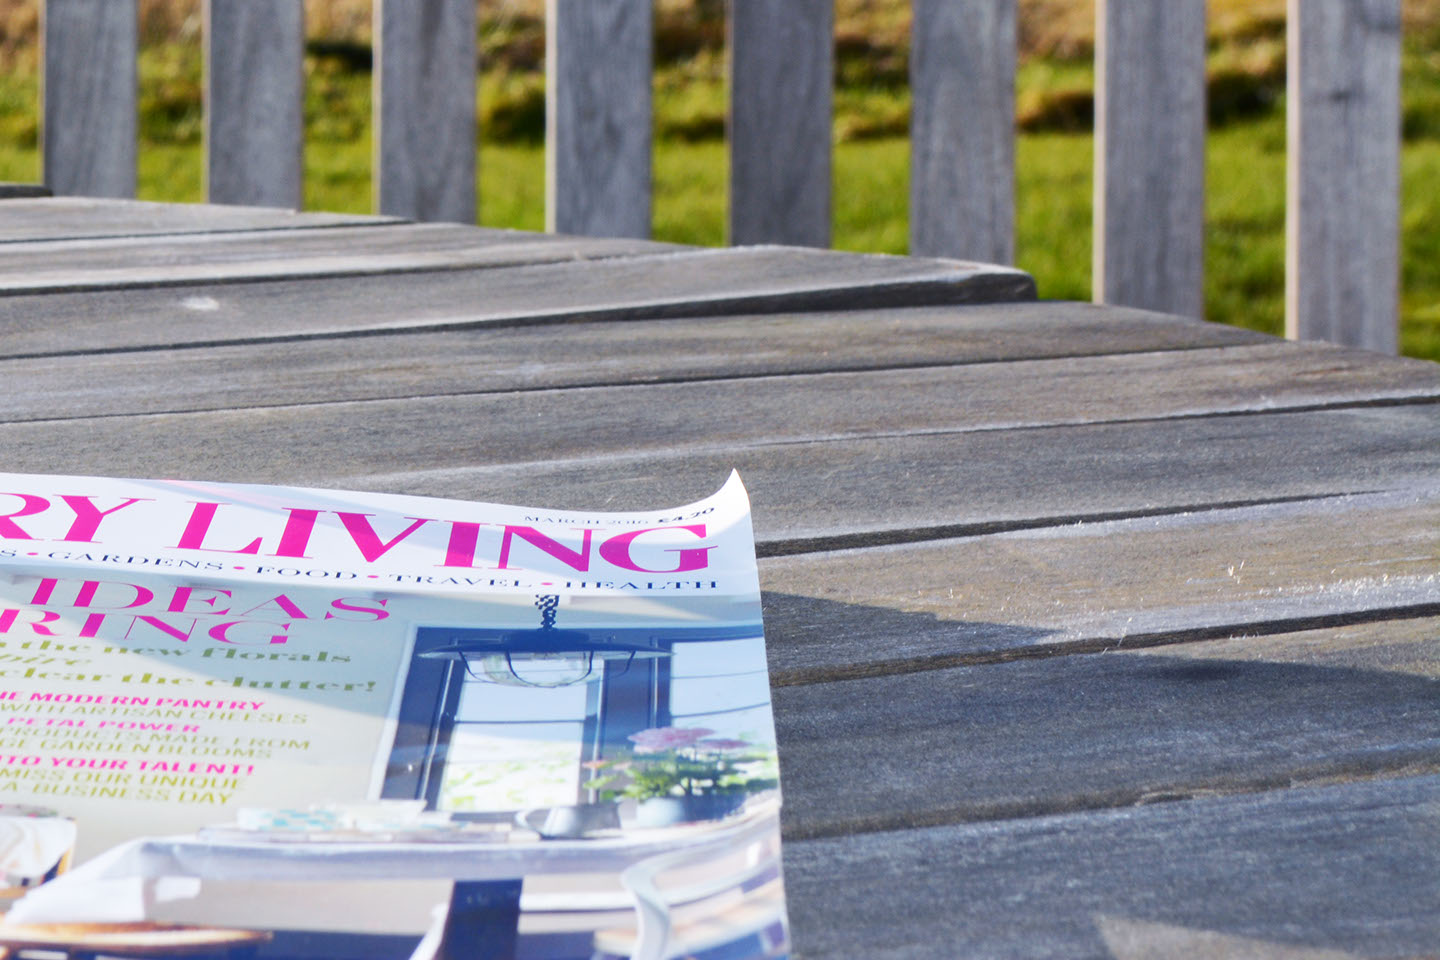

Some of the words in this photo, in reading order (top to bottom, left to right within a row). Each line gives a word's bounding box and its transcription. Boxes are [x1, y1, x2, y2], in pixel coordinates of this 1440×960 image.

[164, 501, 718, 573] LIVING
[47, 551, 223, 570] GARDENS
[256, 566, 357, 580] FOOD
[389, 574, 532, 588] TRAVEL
[565, 581, 719, 589] HEALTH
[28, 577, 390, 622] IDEAS
[20, 640, 91, 651] the
[103, 646, 191, 656] new
[201, 647, 352, 662] florals
[120, 672, 194, 685] the
[204, 676, 376, 691] clutter!
[29, 692, 150, 706] MODERN
[155, 697, 265, 710] PANTRY
[0, 702, 65, 713] WITH
[71, 705, 184, 719] ARTISAN
[189, 710, 308, 724] CHEESES
[7, 717, 89, 728] PETAL
[98, 720, 201, 733] POWER
[39, 739, 151, 753] GARDEN
[156, 743, 272, 759] BLOOMS
[150, 732, 221, 745] MADE
[233, 736, 310, 750] FROM
[51, 756, 128, 770] YOUR
[137, 760, 254, 776] TALENT!
[72, 771, 132, 785] OUR
[139, 774, 245, 790] UNIQUE
[178, 791, 233, 805] DAY
